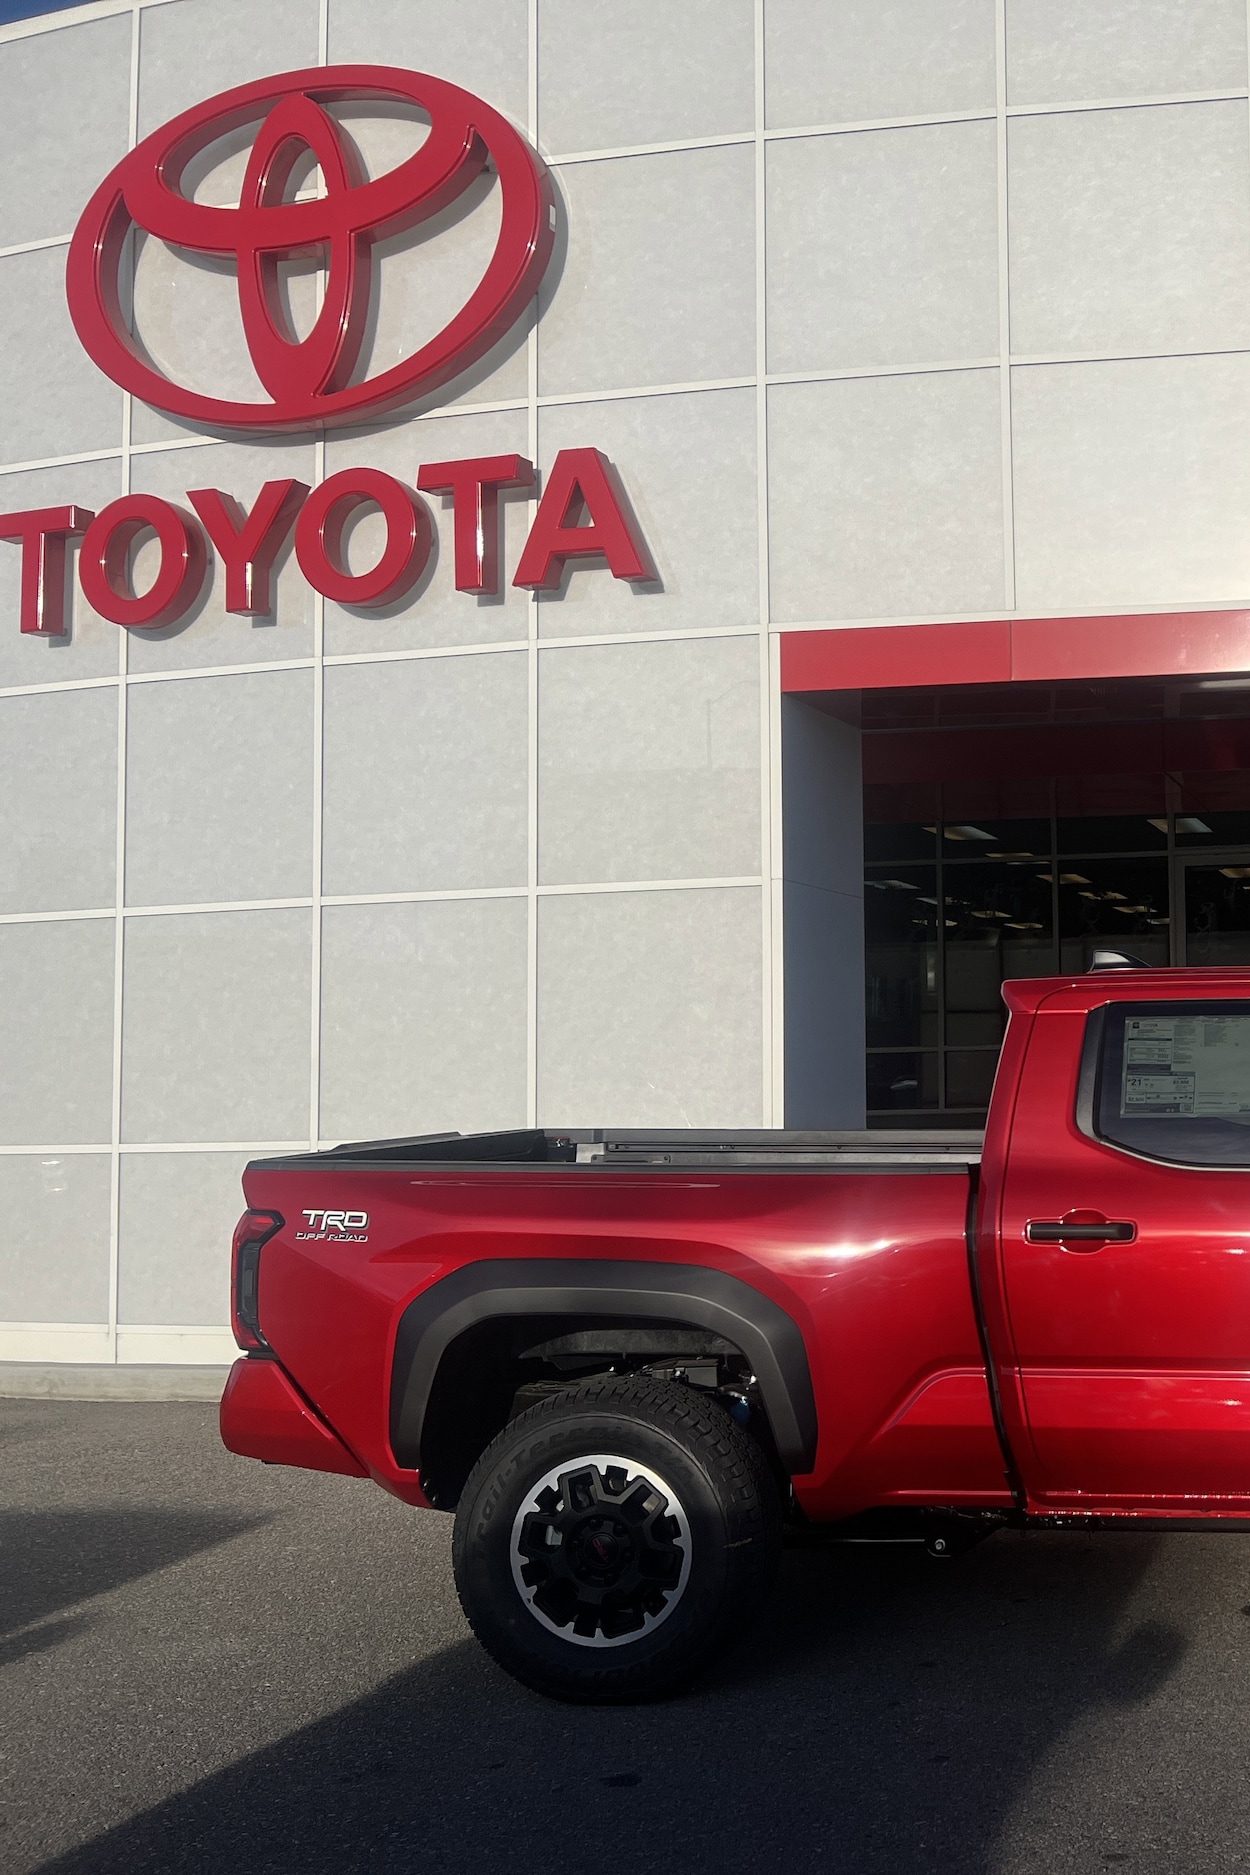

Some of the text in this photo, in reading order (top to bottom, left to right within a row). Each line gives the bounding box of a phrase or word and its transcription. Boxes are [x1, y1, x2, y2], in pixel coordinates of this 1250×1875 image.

[0, 447, 656, 637] TOYOTA
[302, 1209, 369, 1232] TRD
[295, 1232, 369, 1242] OFF ROAD
